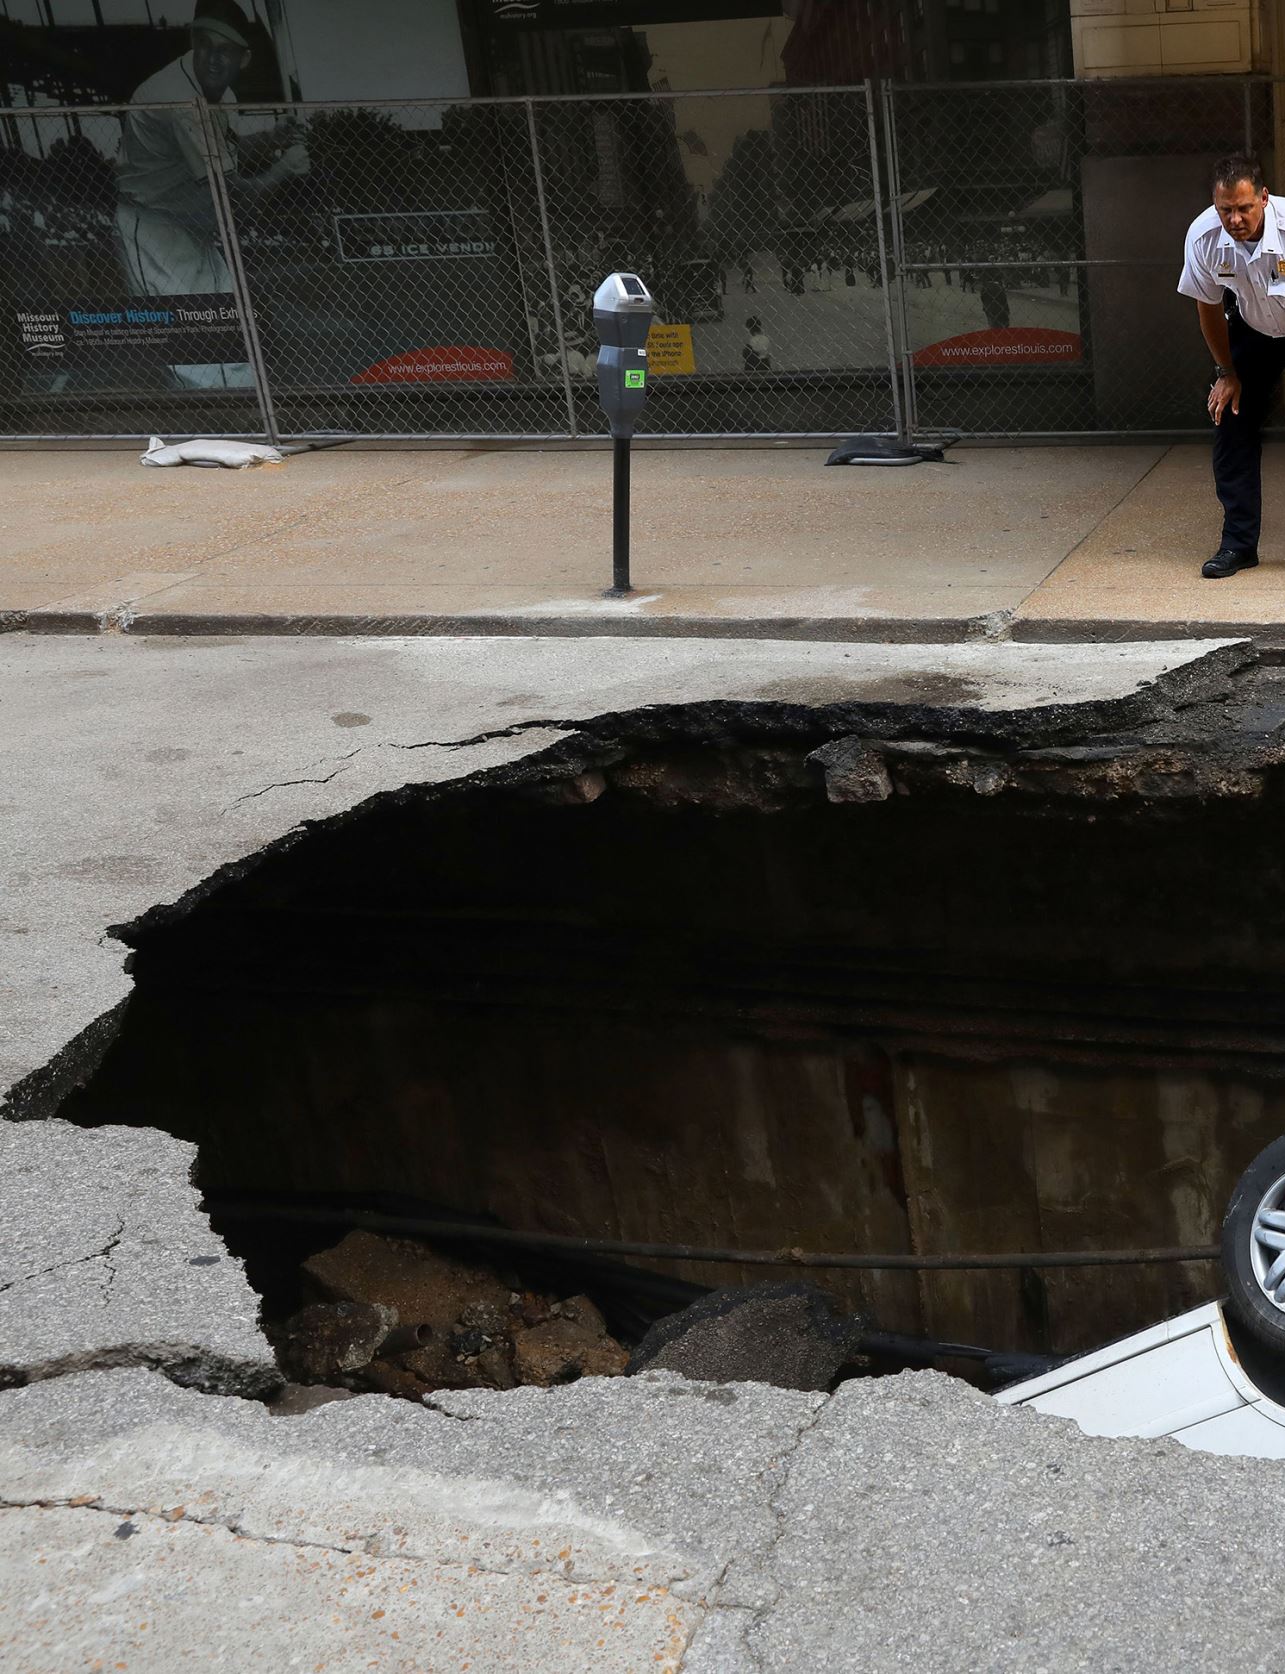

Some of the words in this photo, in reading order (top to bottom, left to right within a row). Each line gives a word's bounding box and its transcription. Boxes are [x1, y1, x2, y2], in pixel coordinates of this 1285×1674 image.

[17, 312, 60, 322] Missouri
[70, 311, 122, 325] Discover
[125, 310, 175, 325] History:
[177, 308, 218, 322] Through
[22, 323, 59, 334] History
[22, 333, 65, 343] Museum
[941, 343, 1073, 357] www.explorestlouis.com
[388, 361, 507, 374] www.explorestlouis.com
